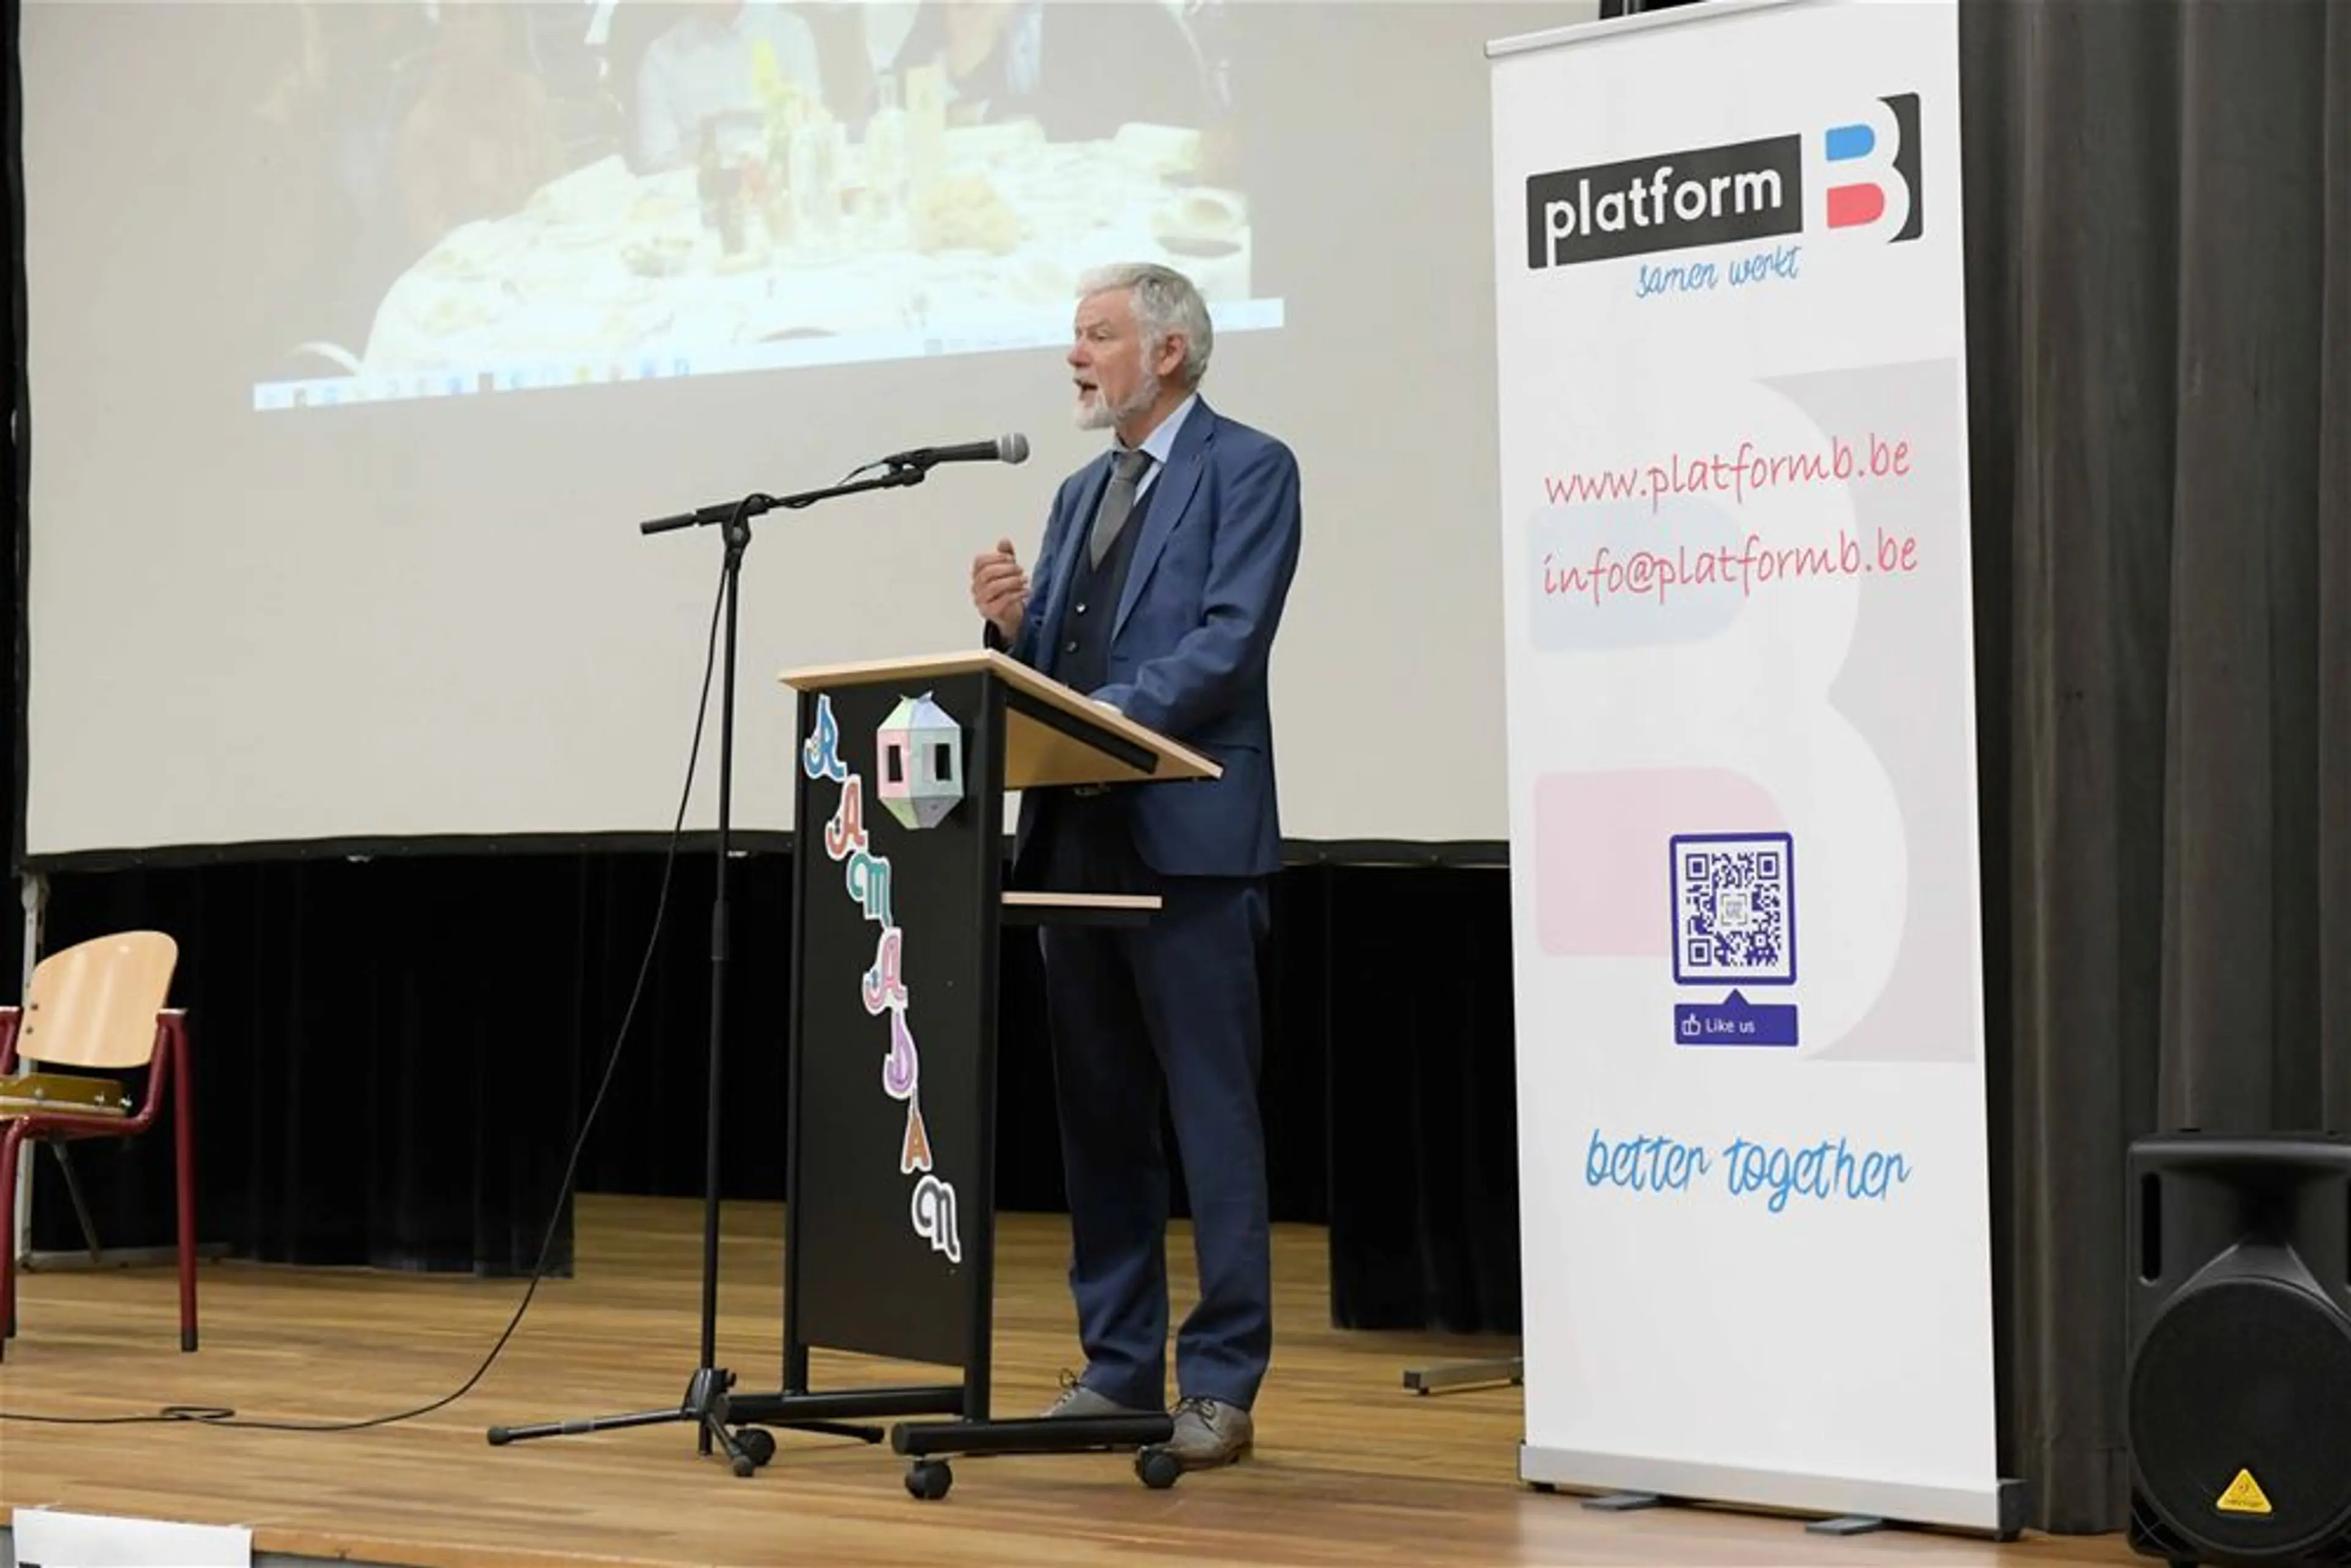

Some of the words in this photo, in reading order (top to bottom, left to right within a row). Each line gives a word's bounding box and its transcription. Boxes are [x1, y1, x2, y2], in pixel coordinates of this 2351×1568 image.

[1545, 166, 1783, 268] platform
[1635, 262, 1718, 298] samen
[1728, 246, 1802, 285] werkt
[1545, 433, 1911, 513] www.platformb.be
[1543, 527, 1919, 606] info@platformb.be
[1705, 1019, 1734, 1033] Like
[1739, 1021, 1755, 1033] us
[1586, 1128, 1712, 1193] better
[1723, 1136, 1913, 1214] together
